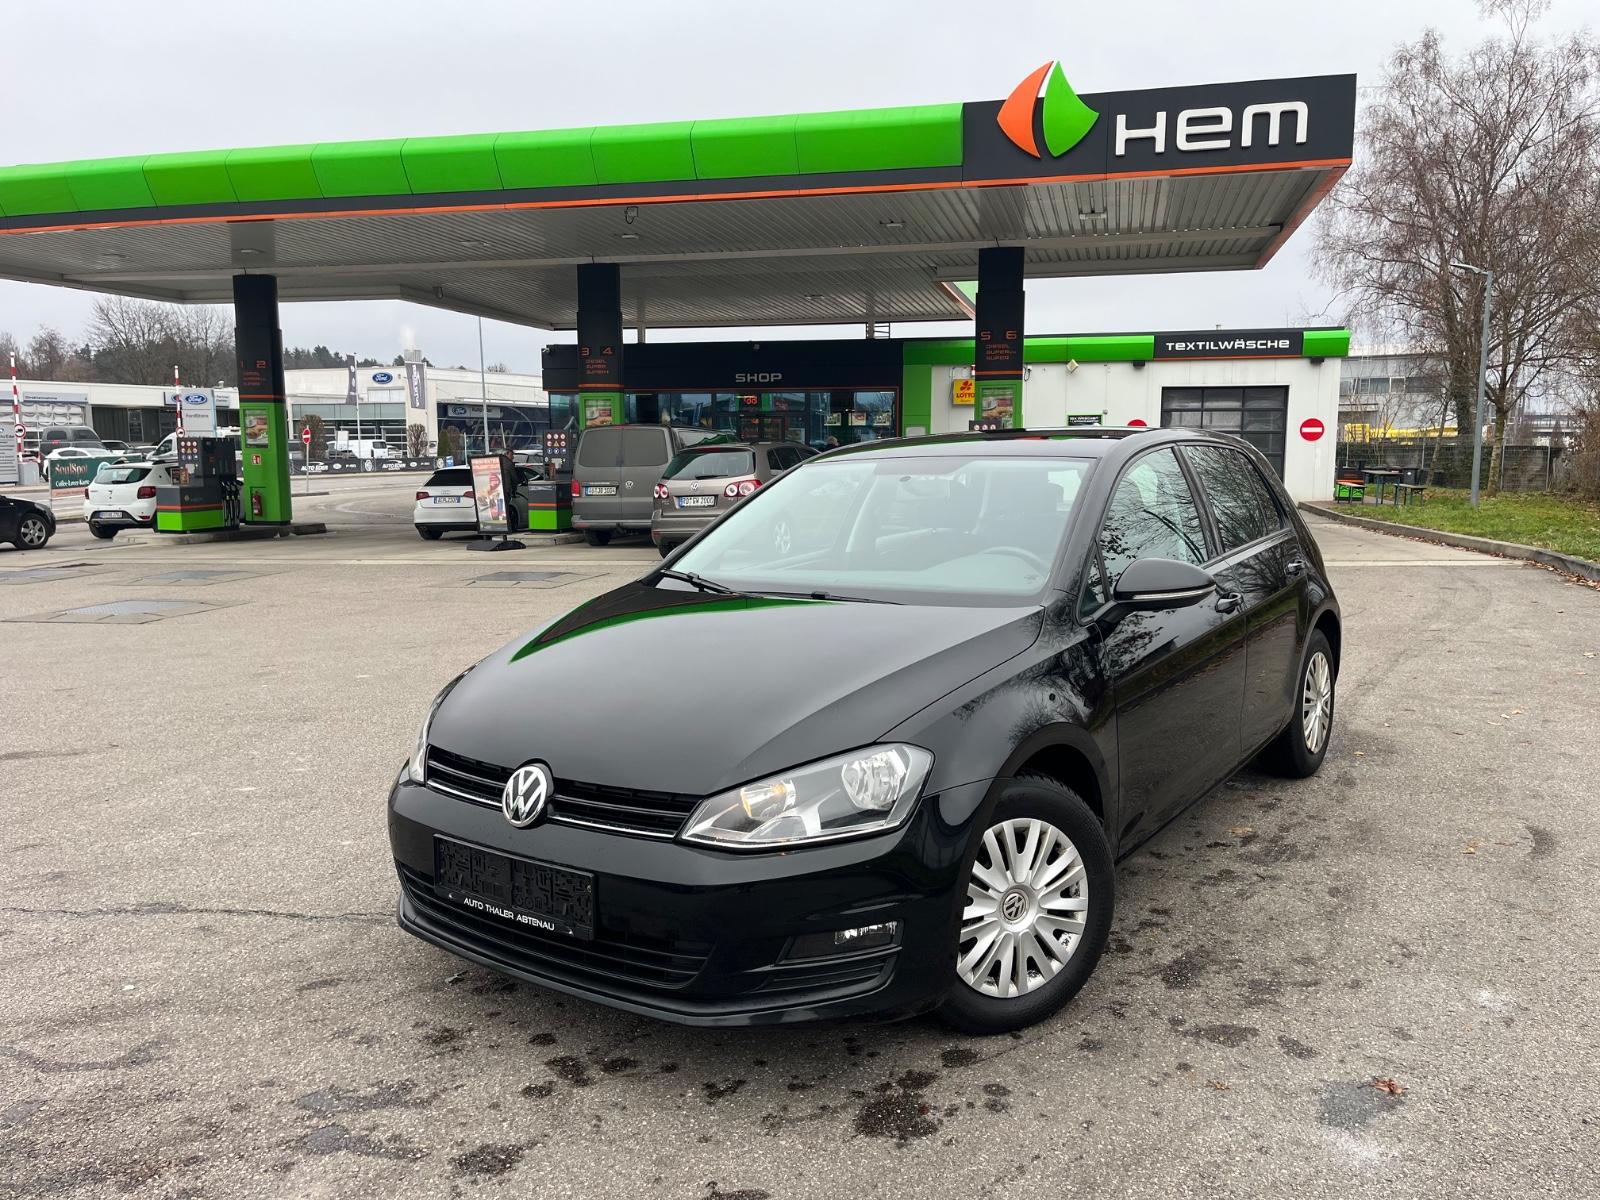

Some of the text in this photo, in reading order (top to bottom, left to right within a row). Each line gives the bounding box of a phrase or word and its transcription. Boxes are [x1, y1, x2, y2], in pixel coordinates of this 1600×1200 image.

[1006, 331, 1017, 339] 6
[581, 346, 613, 356] 3 4
[735, 372, 782, 383] SHOP
[463, 897, 555, 931] AUTO THALER ABTENAU
